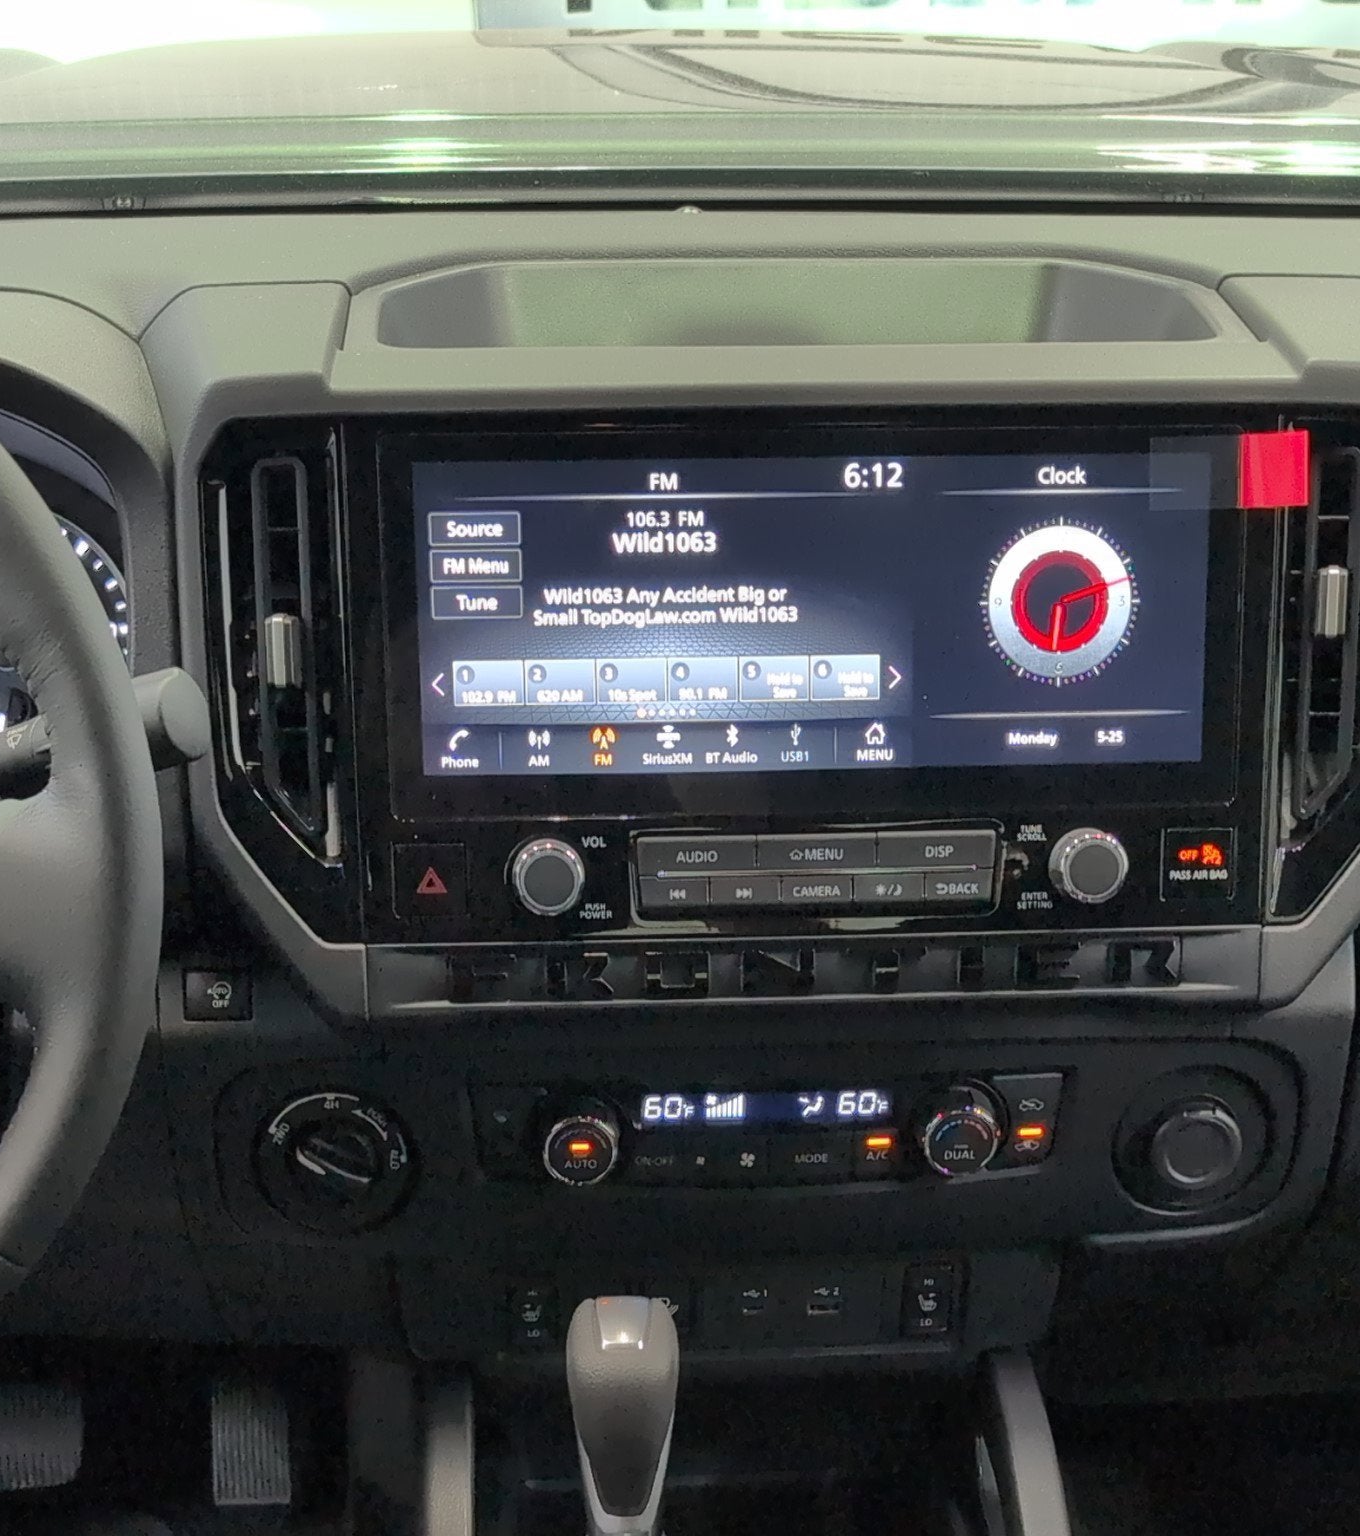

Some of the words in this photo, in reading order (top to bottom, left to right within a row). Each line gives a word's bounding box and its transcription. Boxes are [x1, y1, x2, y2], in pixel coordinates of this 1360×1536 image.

[649, 473, 678, 491] FM
[844, 462, 903, 488] 6:12
[1037, 466, 1086, 485] Clock
[626, 511, 670, 527] 106.3
[679, 511, 704, 527] FM
[446, 520, 504, 538] Source
[612, 531, 717, 553] Wild1063
[443, 558, 465, 575] FM
[468, 557, 510, 574] Menu
[455, 594, 498, 611] Tune
[544, 588, 623, 605] Wild1063
[626, 588, 660, 608] Any
[662, 585, 735, 604] Accident
[738, 586, 765, 606] Big
[768, 588, 788, 603] or
[533, 609, 578, 627] Small
[580, 609, 716, 629] TopDogLaw.com
[719, 607, 798, 624] Wild1063
[533, 669, 543, 682] 2
[604, 667, 614, 681] 3
[675, 666, 685, 679] 4
[747, 665, 757, 679] 5
[818, 664, 828, 677] 6
[1008, 731, 1058, 747] Monday
[1097, 730, 1124, 743] 5-25
[441, 756, 480, 769] Phone
[528, 755, 550, 767] AM
[594, 754, 613, 766] FM
[643, 752, 693, 766] SiriusXM
[705, 752, 720, 765] BT
[722, 750, 758, 766] Audio
[856, 749, 894, 762] MENU
[581, 835, 607, 849] VOL
[676, 849, 718, 864] AUDIO
[804, 847, 844, 861] MENU
[925, 844, 954, 859] DISP
[1169, 869, 1191, 880] PASS
[792, 884, 840, 898] CAMERA
[949, 881, 979, 895] BACK
[323, 1100, 340, 1110] 4H
[795, 1153, 828, 1164] MODE
[865, 1151, 889, 1162] A/C
[944, 1149, 976, 1161] DUAL
[564, 1158, 598, 1170] AUTO
